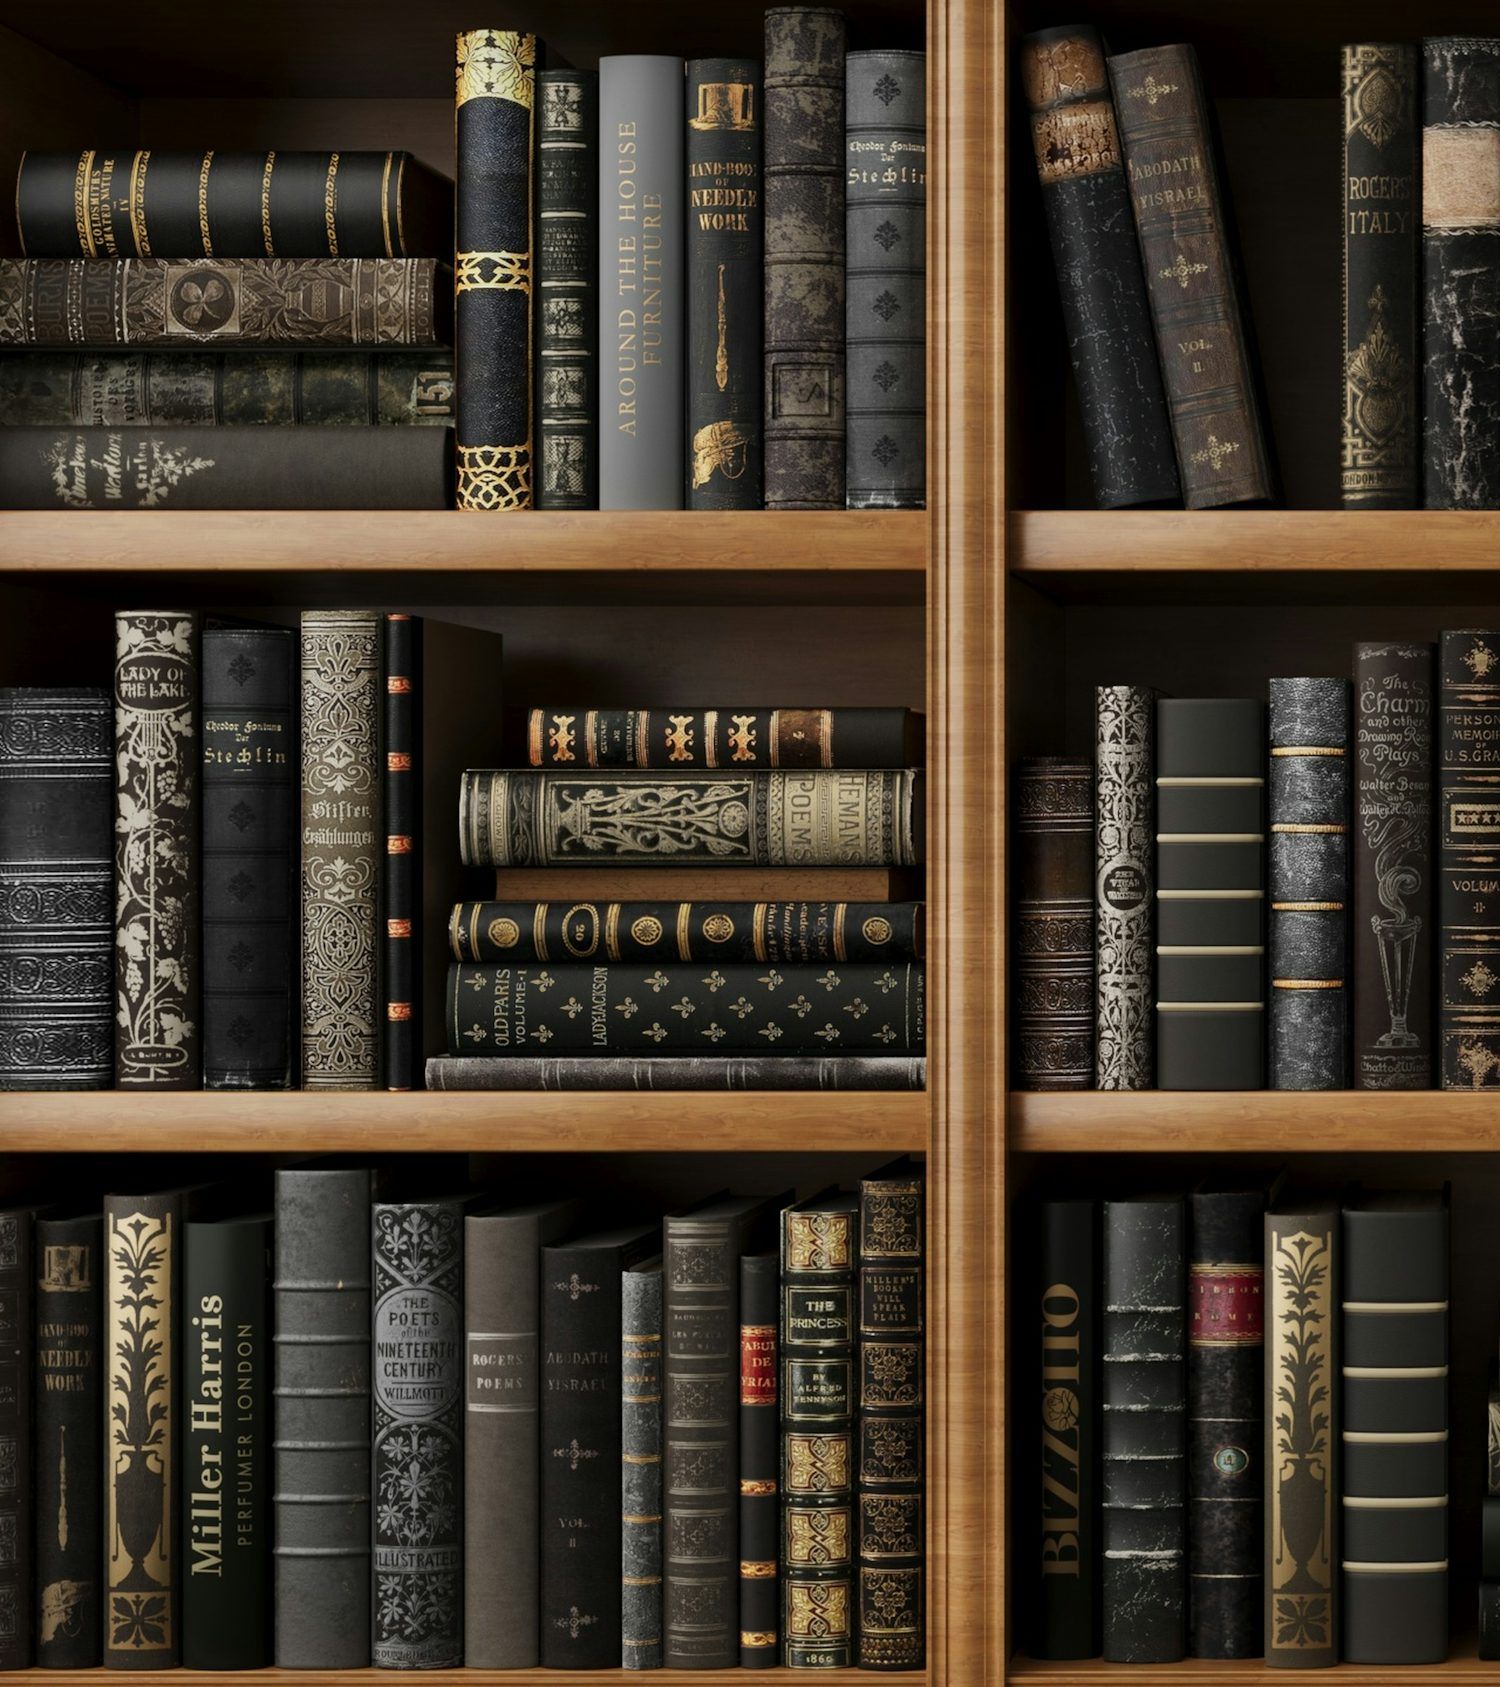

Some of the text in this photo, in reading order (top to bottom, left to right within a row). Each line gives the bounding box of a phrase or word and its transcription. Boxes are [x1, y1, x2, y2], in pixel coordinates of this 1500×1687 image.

[101, 159, 116, 205] NATURE
[119, 197, 130, 212] IV
[690, 188, 759, 208] NEEDLE
[1138, 185, 1204, 210] YISRAEL
[90, 168, 105, 246] GOLDSMITHS
[698, 212, 751, 232] WORK
[1349, 209, 1411, 235] ITALY
[617, 120, 637, 438] AROUND THE HOUSE
[642, 192, 663, 367] FURNITURE
[417, 266, 432, 338] LOVELL
[417, 370, 451, 415] 151
[119, 665, 161, 682] LADY
[1382, 673, 1410, 691] The
[119, 682, 148, 699] THE
[1360, 691, 1432, 714] Charm
[1367, 714, 1425, 728] and other
[1357, 729, 1403, 745] Drawing
[1475, 741, 1487, 750] OF
[203, 746, 287, 766] Stechlin
[1372, 743, 1420, 768] Plays
[1396, 776, 1431, 792] Besan
[788, 774, 817, 863] POEMS
[838, 772, 866, 866] HEMANS
[574, 923, 586, 942] 20
[592, 966, 609, 1009] JACKSON
[493, 968, 512, 1047] OLD PARIS
[864, 1275, 916, 1285] MILLER'S
[872, 1284, 904, 1293] BOOKS
[402, 1297, 430, 1310] THE
[805, 1300, 837, 1313] THE
[871, 1302, 907, 1312] SPEAK
[388, 1311, 440, 1327] POETS
[789, 1316, 848, 1330] PRINCESS
[873, 1312, 907, 1322] PLAIN
[1193, 1311, 1257, 1322] ROME
[39, 1349, 93, 1367] NEEDLE
[376, 1341, 457, 1360] NINETEENTH
[546, 1351, 609, 1365] ABODATH
[383, 1361, 445, 1379] CENTURY
[751, 1356, 773, 1368] DE
[43, 1373, 86, 1392] WORK
[475, 1376, 523, 1390] POEMS
[547, 1378, 609, 1392] YISRAEL
[812, 1373, 826, 1382] BY
[383, 1387, 446, 1401] WILLMOTT
[798, 1384, 843, 1393] ALFRED
[792, 1394, 847, 1404] TENNYSON
[191, 1293, 223, 1578] Miller Harris
[236, 1323, 253, 1547] PERFUMER LONDON
[374, 1551, 458, 1569] ILLUSTRATED
[805, 1653, 835, 1665] 1860
